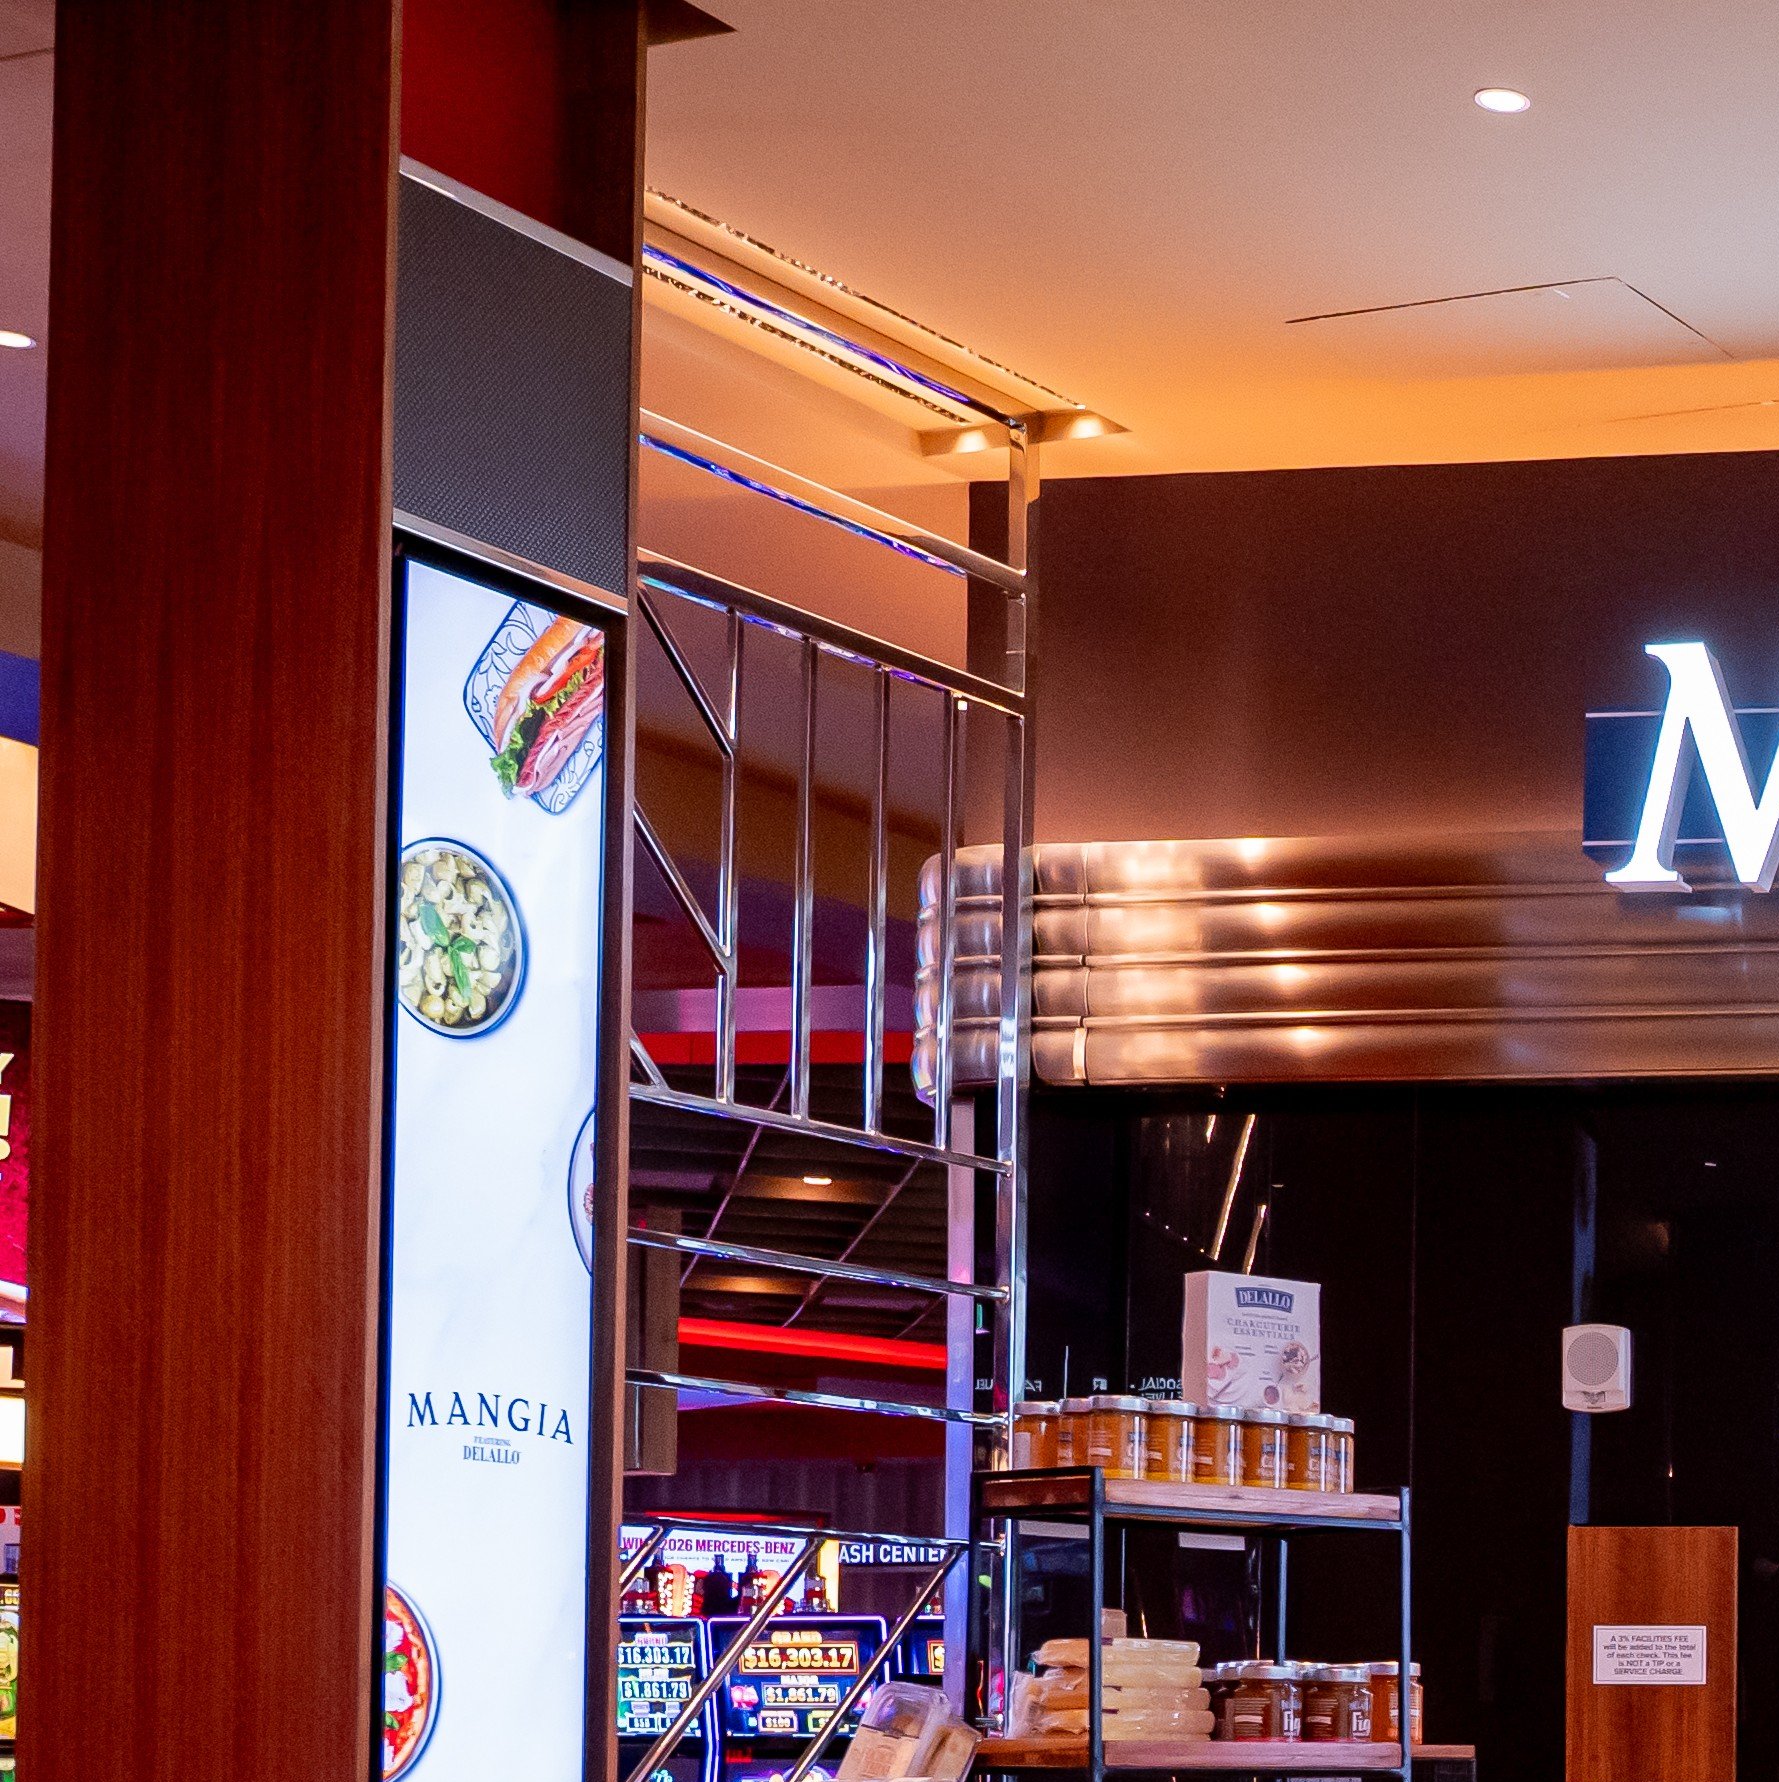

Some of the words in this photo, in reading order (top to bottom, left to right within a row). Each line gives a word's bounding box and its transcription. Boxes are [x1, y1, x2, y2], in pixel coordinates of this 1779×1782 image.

[1239, 1290, 1291, 1309] DELALLO
[407, 1391, 574, 1444] MANGIA
[463, 1445, 521, 1465] DELALLO
[661, 1538, 693, 1552] 2026
[695, 1539, 795, 1555] MERCEDES-BENZ
[837, 1542, 875, 1564] ASH
[743, 1647, 853, 1669] $16,303.17
